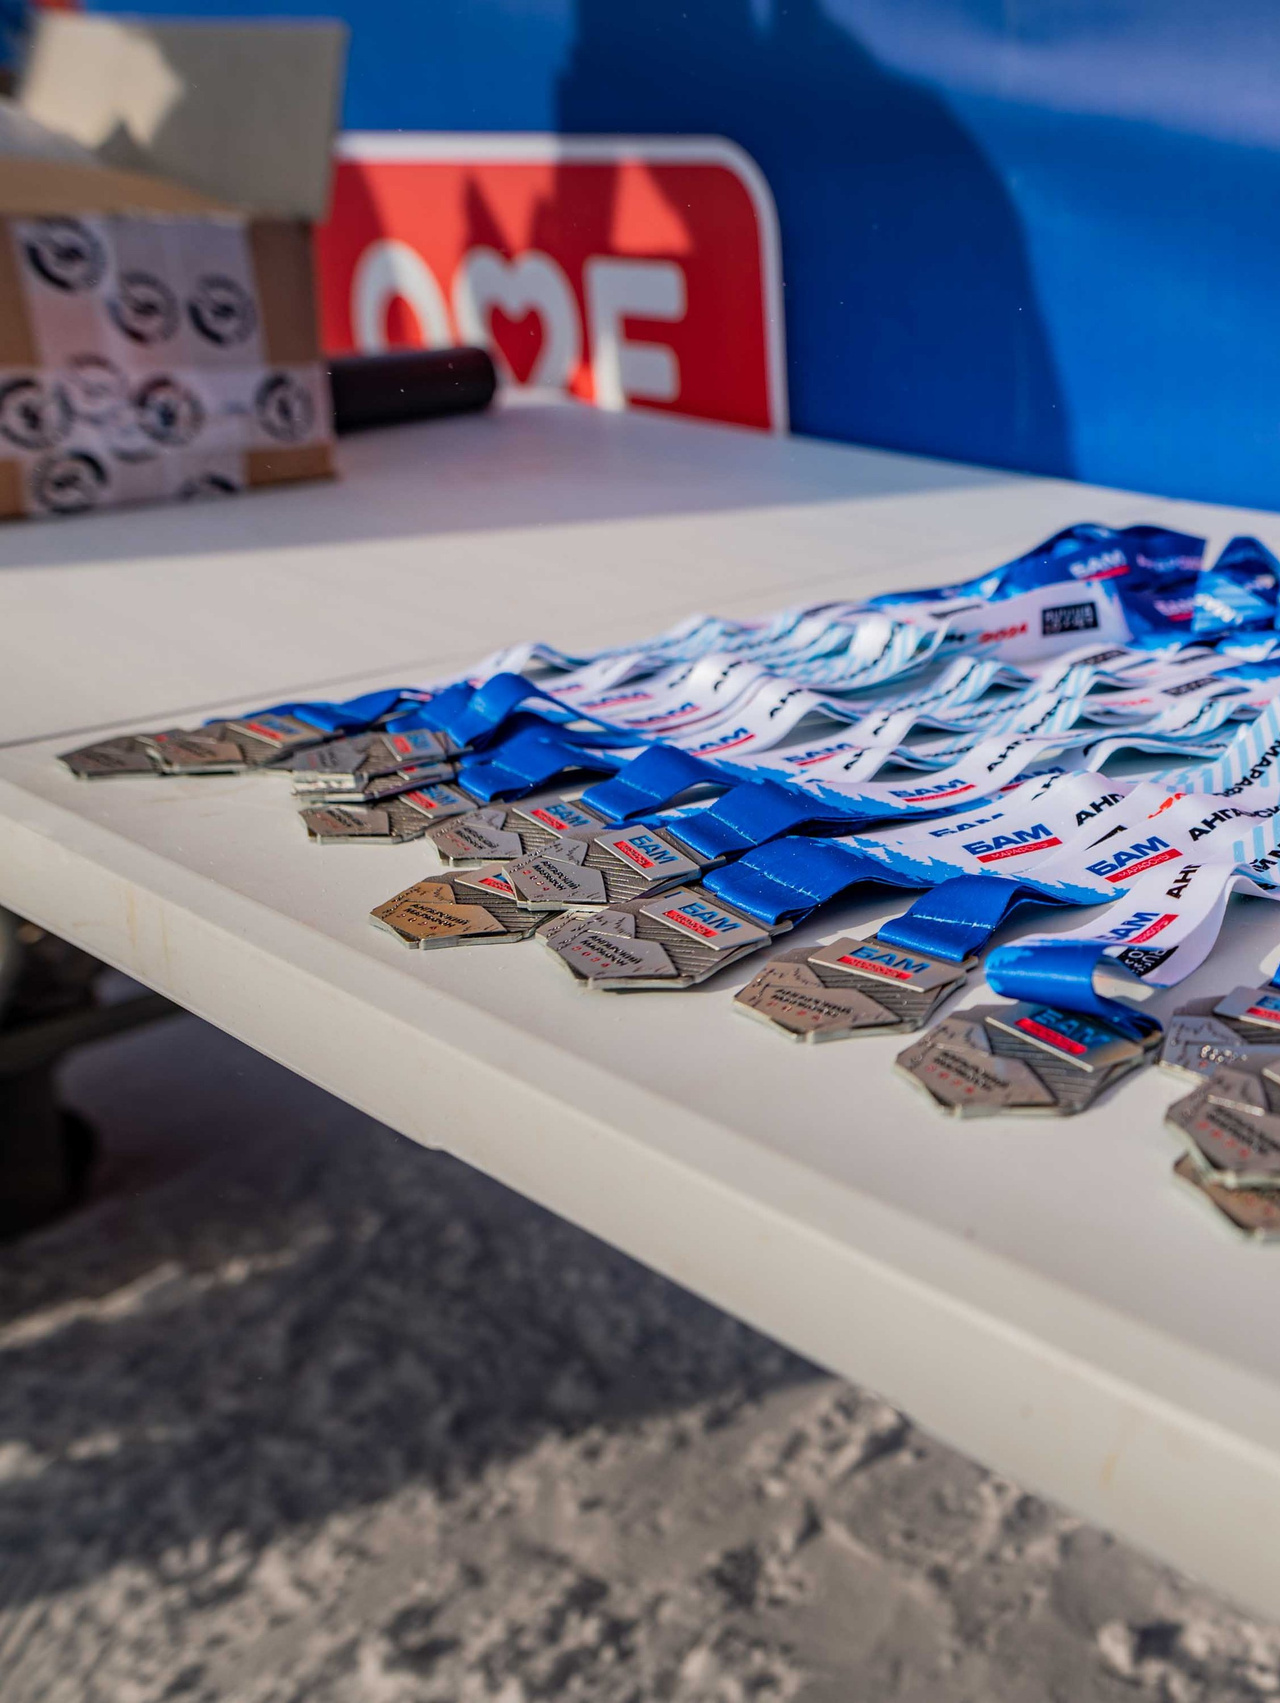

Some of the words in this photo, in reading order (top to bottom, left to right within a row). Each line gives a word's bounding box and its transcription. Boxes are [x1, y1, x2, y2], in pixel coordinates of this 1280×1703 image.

[888, 778, 969, 798] БАМ
[629, 835, 679, 864] БАМ
[961, 823, 1054, 856] БАМ
[1085, 835, 1170, 876] БАМ
[678, 902, 743, 932] БАМ
[850, 946, 931, 974] БАМ
